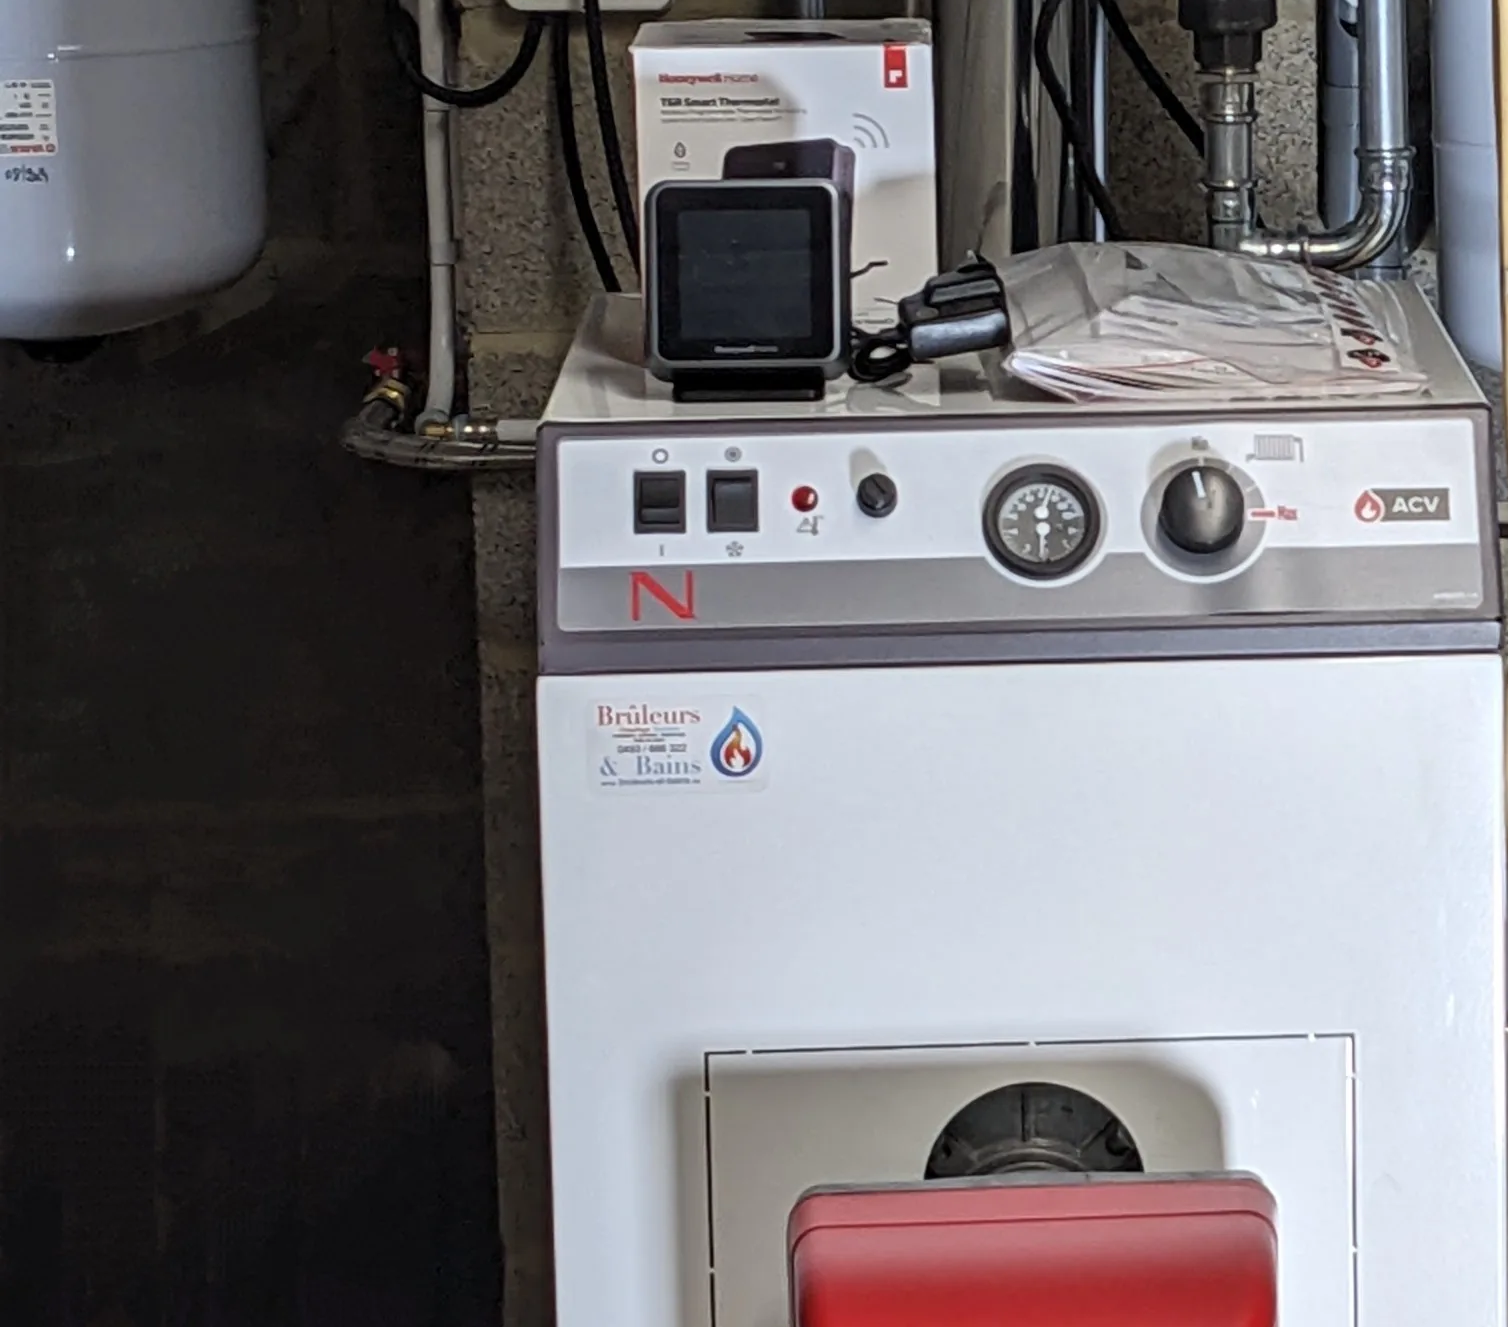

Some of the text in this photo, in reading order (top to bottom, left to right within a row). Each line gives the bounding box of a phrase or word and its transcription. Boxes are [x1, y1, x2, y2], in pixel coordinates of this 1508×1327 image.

[1392, 497, 1440, 513] ACV
[629, 570, 696, 621] N
[598, 704, 701, 726] Brûleurs
[599, 755, 702, 776] & Bains
